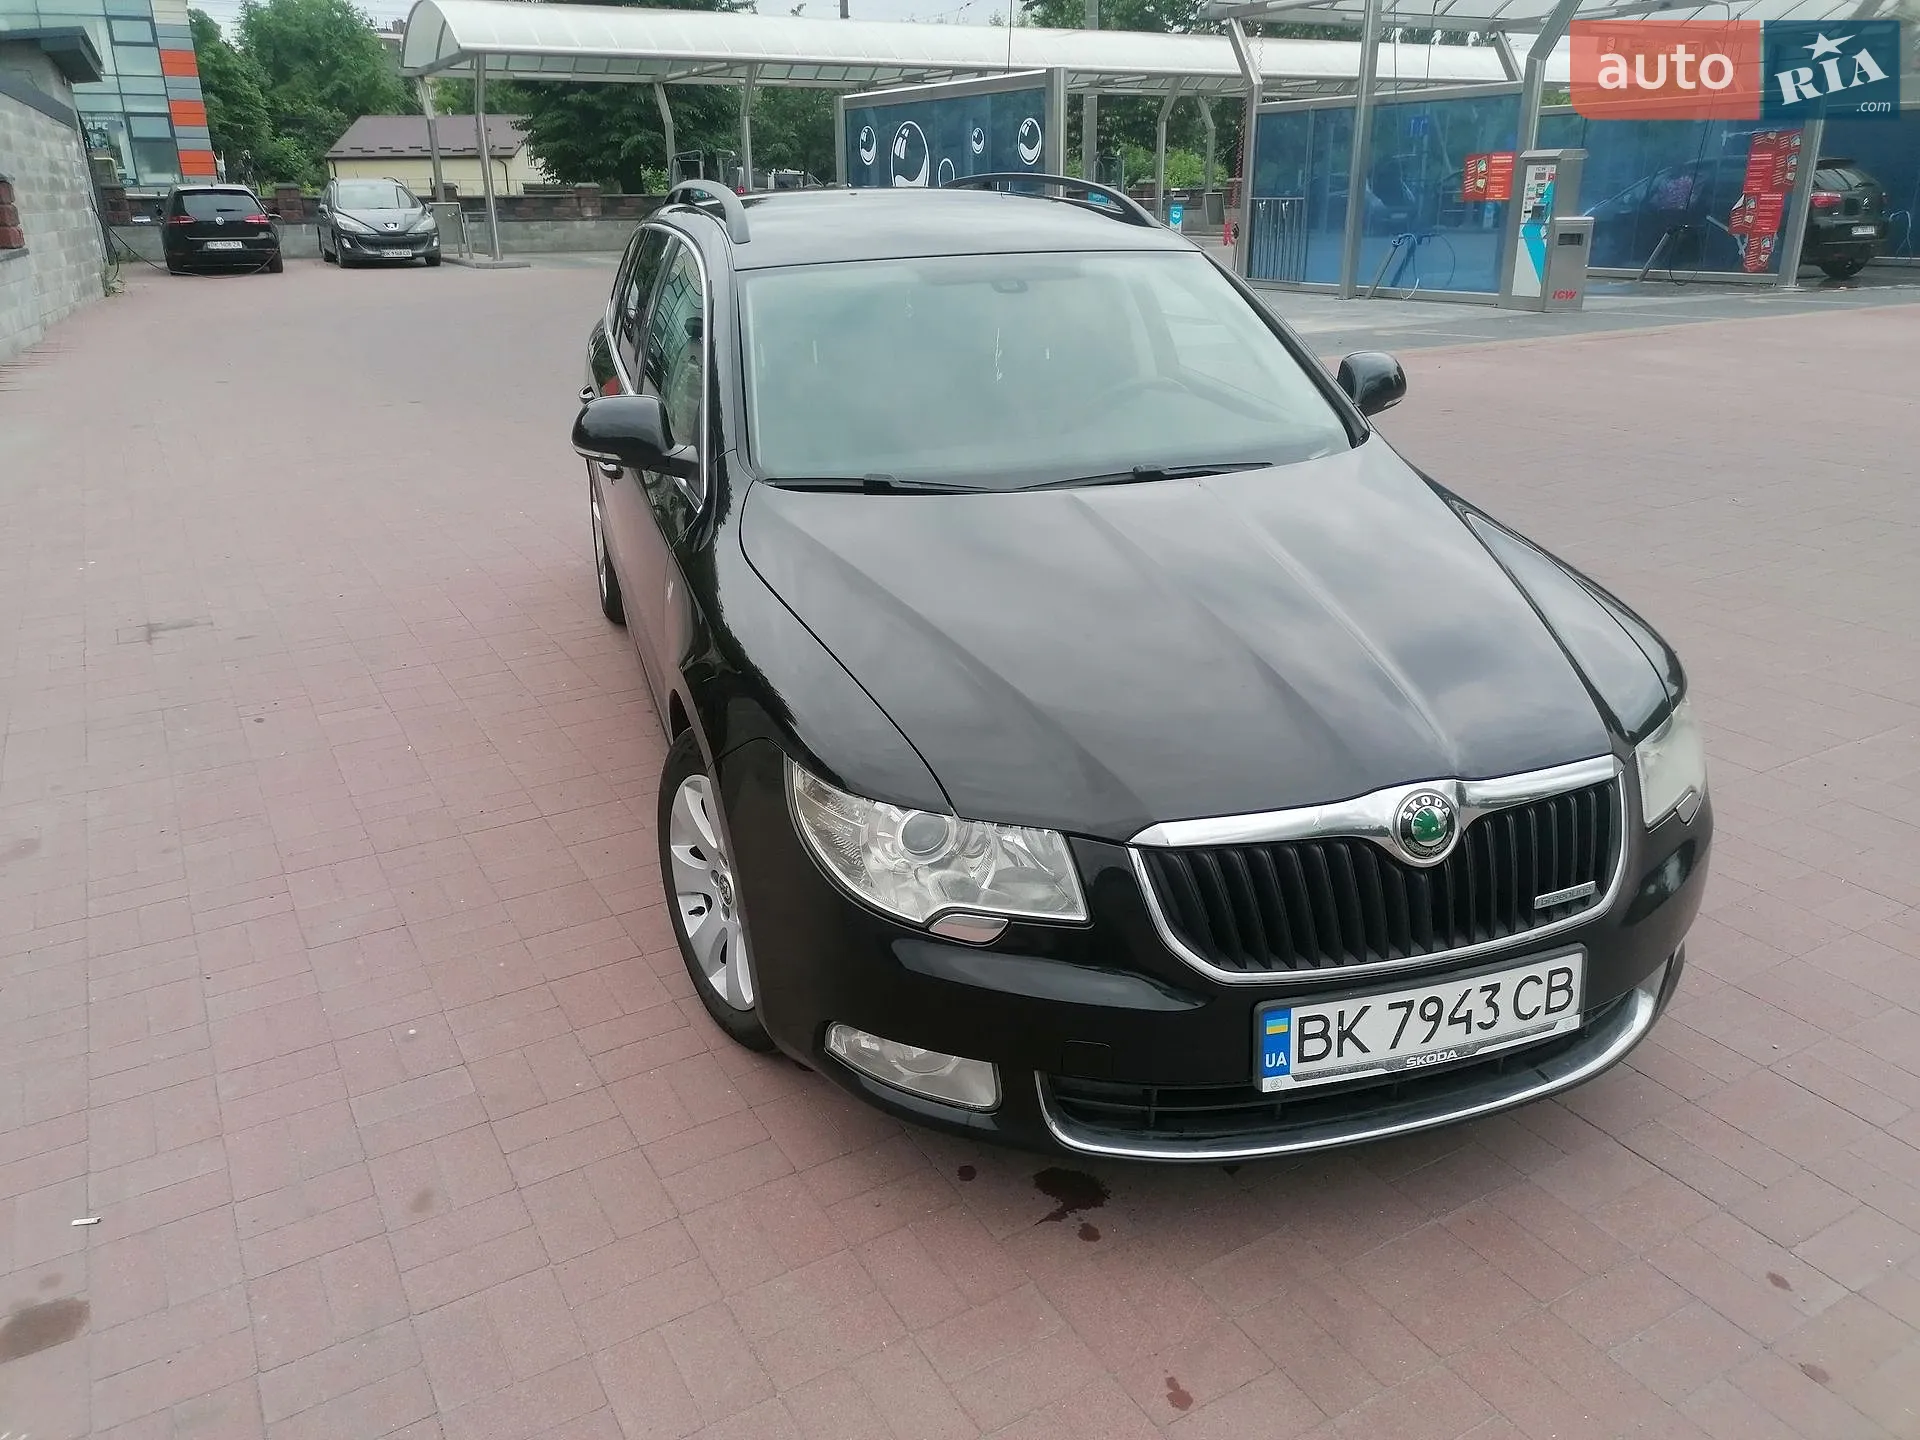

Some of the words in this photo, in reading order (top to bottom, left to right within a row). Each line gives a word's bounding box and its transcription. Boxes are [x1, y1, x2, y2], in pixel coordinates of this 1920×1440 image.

[1552, 289, 1577, 300] ICW
[1296, 1005, 1371, 1064] BK
[1387, 982, 1502, 1050] 7943
[1512, 966, 1574, 1021] CB
[1264, 1051, 1288, 1068] UA
